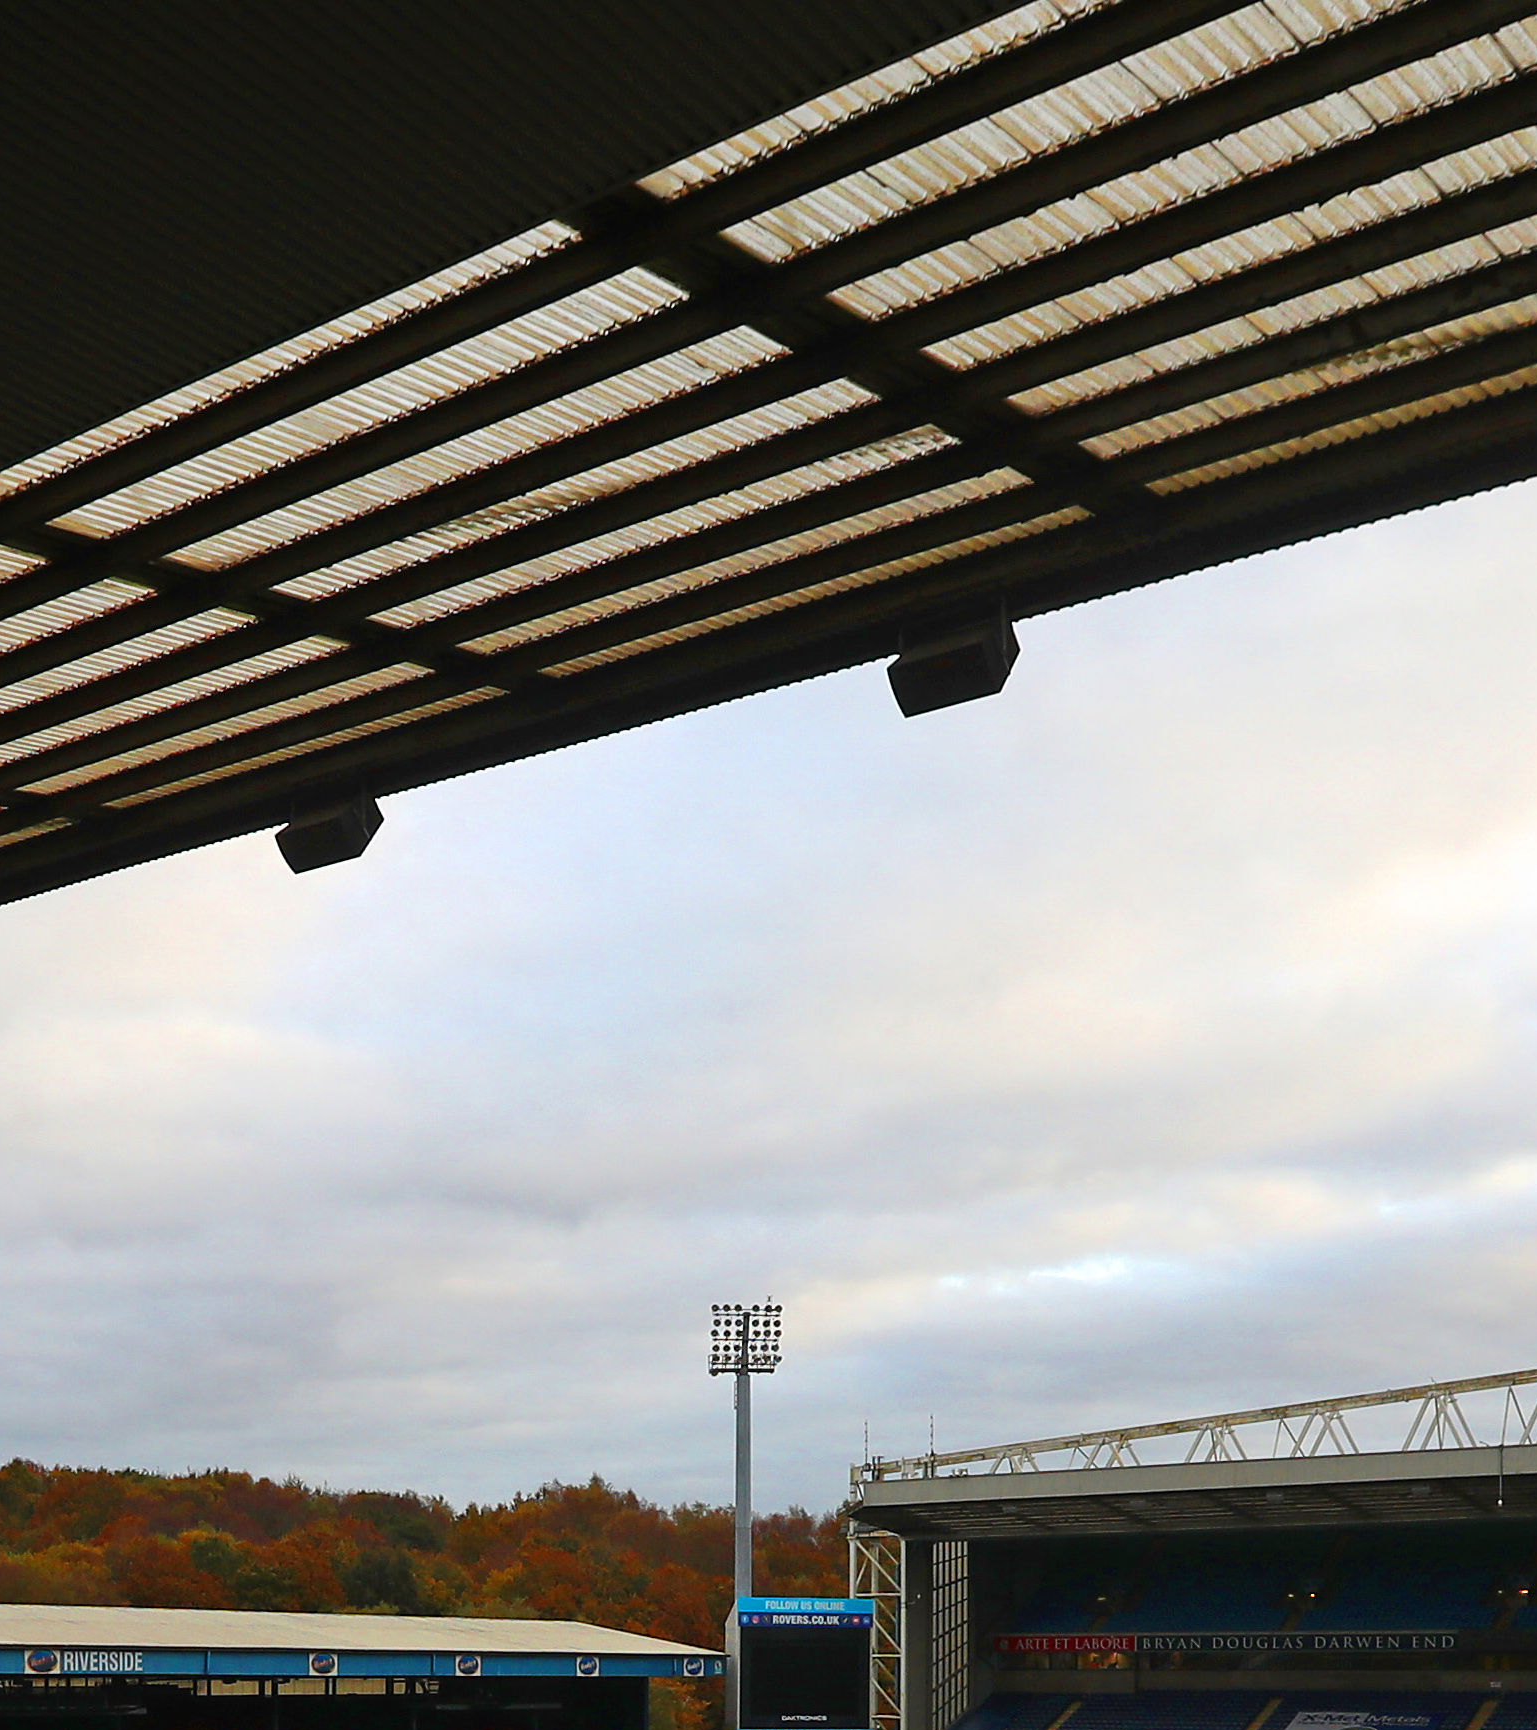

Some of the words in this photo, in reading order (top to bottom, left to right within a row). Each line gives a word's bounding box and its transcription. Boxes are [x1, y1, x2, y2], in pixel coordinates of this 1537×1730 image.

[765, 1600, 798, 1611] FOLLOW
[800, 1601, 812, 1611] US
[814, 1601, 845, 1612] ONLINE
[772, 1615, 840, 1626] ROVERS.CO.UK
[1016, 1638, 1050, 1650] ARTE
[1055, 1638, 1069, 1650] ET
[1074, 1638, 1130, 1650] LABORE
[1143, 1637, 1201, 1650] BRYAN
[1212, 1636, 1304, 1650] DOUGLAS
[1315, 1635, 1401, 1649] DARWEN
[1412, 1635, 1456, 1649] END
[63, 1651, 144, 1672] RIVERSIDE
